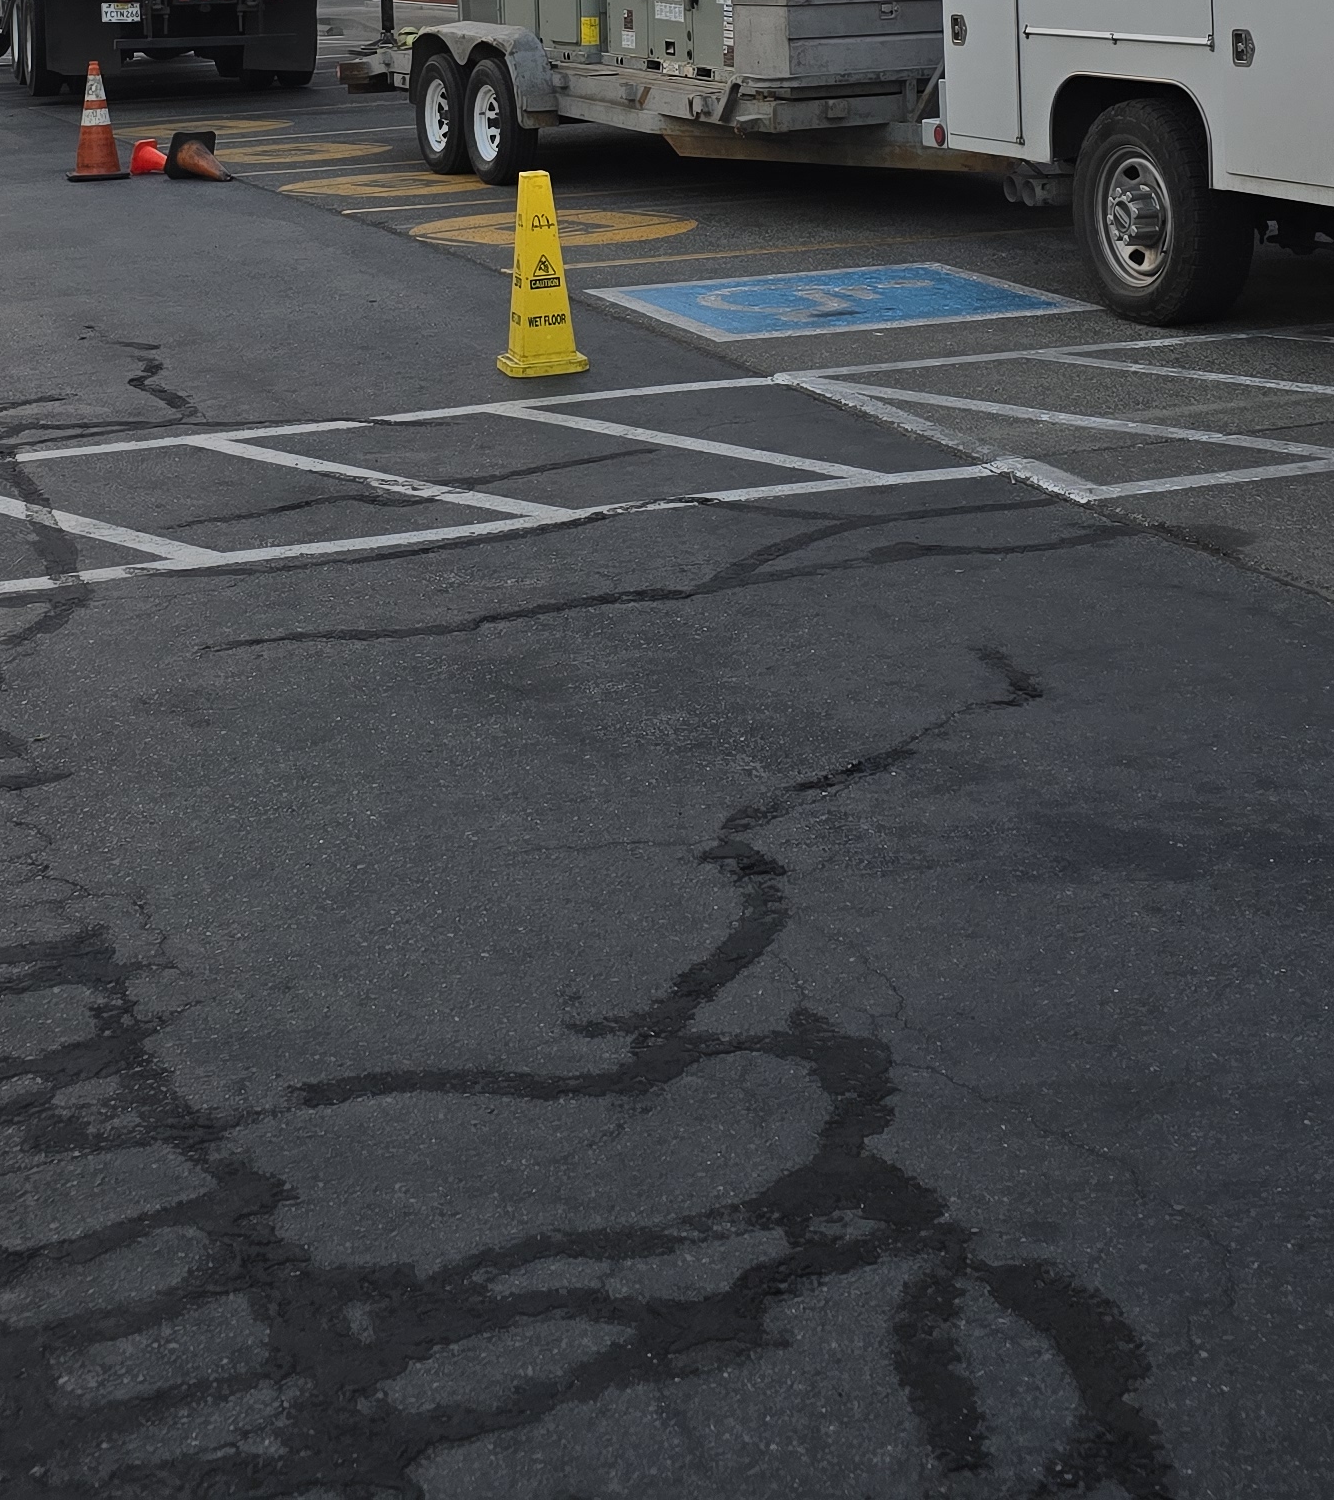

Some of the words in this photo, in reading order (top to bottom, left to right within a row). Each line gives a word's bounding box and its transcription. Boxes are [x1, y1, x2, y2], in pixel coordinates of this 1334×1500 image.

[531, 278, 559, 289] CAUTION
[528, 316, 543, 328] WET
[544, 313, 566, 327] FLOOR
